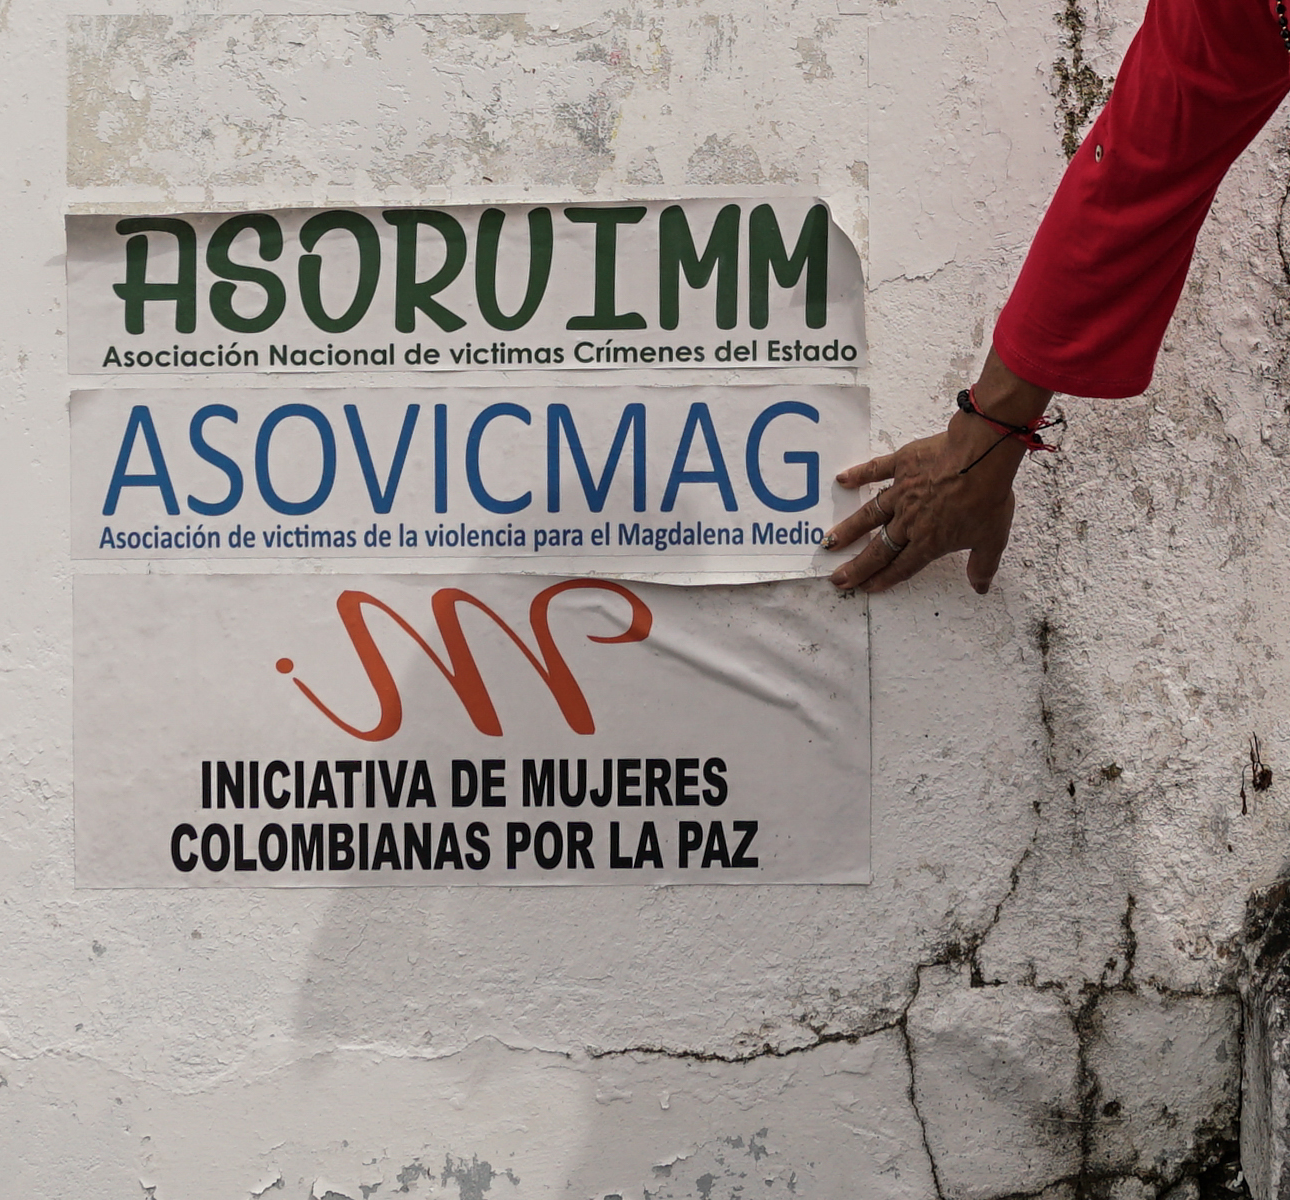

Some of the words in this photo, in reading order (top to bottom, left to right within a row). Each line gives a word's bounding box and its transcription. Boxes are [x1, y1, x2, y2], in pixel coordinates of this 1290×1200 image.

[103, 341, 258, 367] Asociación
[270, 343, 394, 366] Nacional
[405, 343, 440, 364] de
[449, 341, 565, 364] victimas
[574, 338, 705, 363] Crímenes
[715, 339, 758, 362] del
[768, 338, 857, 362] Estado
[102, 401, 820, 517] ASOVICMAG
[100, 523, 220, 550] Asociación
[228, 524, 256, 548] de
[263, 524, 357, 549] victimas
[364, 523, 392, 548] de
[399, 522, 418, 547] la
[425, 522, 526, 548] violencia
[534, 528, 584, 553] para
[590, 521, 611, 547] el
[618, 521, 744, 552] Magdalena
[752, 521, 824, 546] Medio
[202, 760, 435, 809] INICIATIVA
[452, 759, 506, 808] DE
[522, 757, 728, 808] MUJERES
[171, 821, 490, 872] COLOMBIANAS
[507, 821, 595, 870] POR
[610, 821, 661, 869] LA
[678, 820, 759, 869] PAZ
